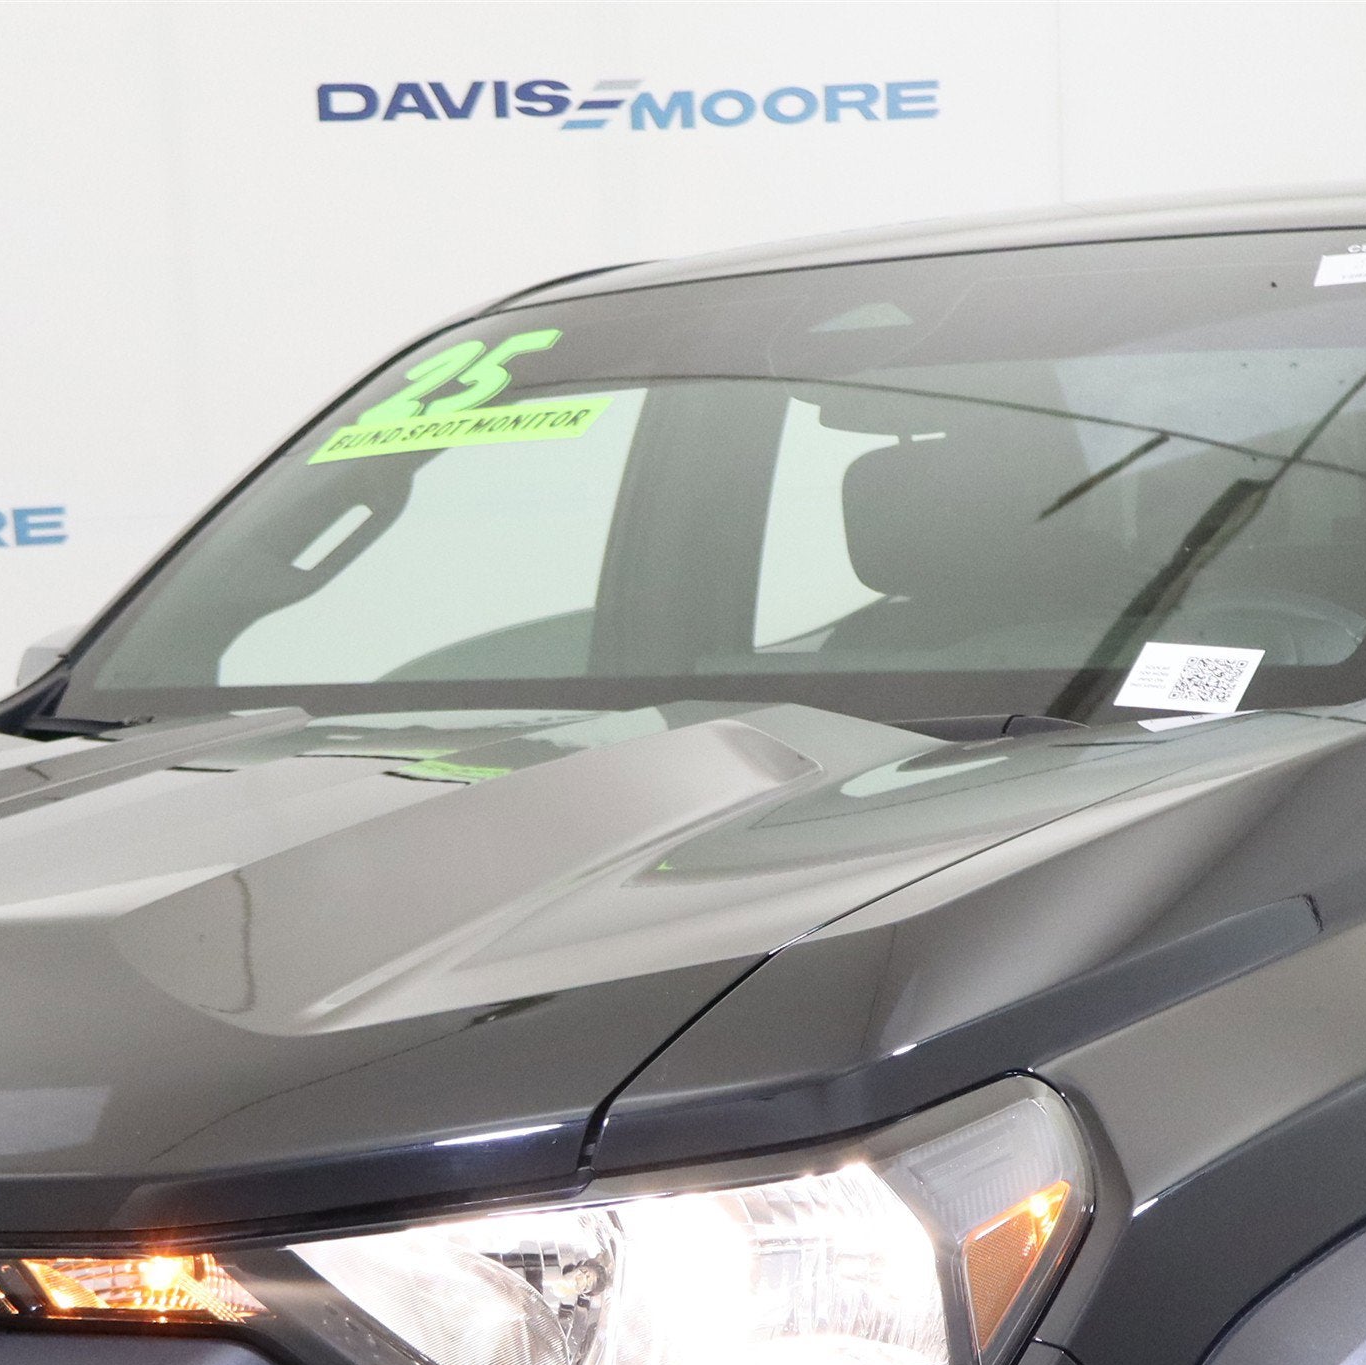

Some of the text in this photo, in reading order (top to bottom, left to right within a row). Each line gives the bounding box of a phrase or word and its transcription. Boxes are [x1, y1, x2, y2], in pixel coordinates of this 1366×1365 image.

[317, 79, 940, 130] DAVIS MOORE
[356, 328, 564, 427] 25
[327, 408, 591, 452] BLIND SPOT MONITOR
